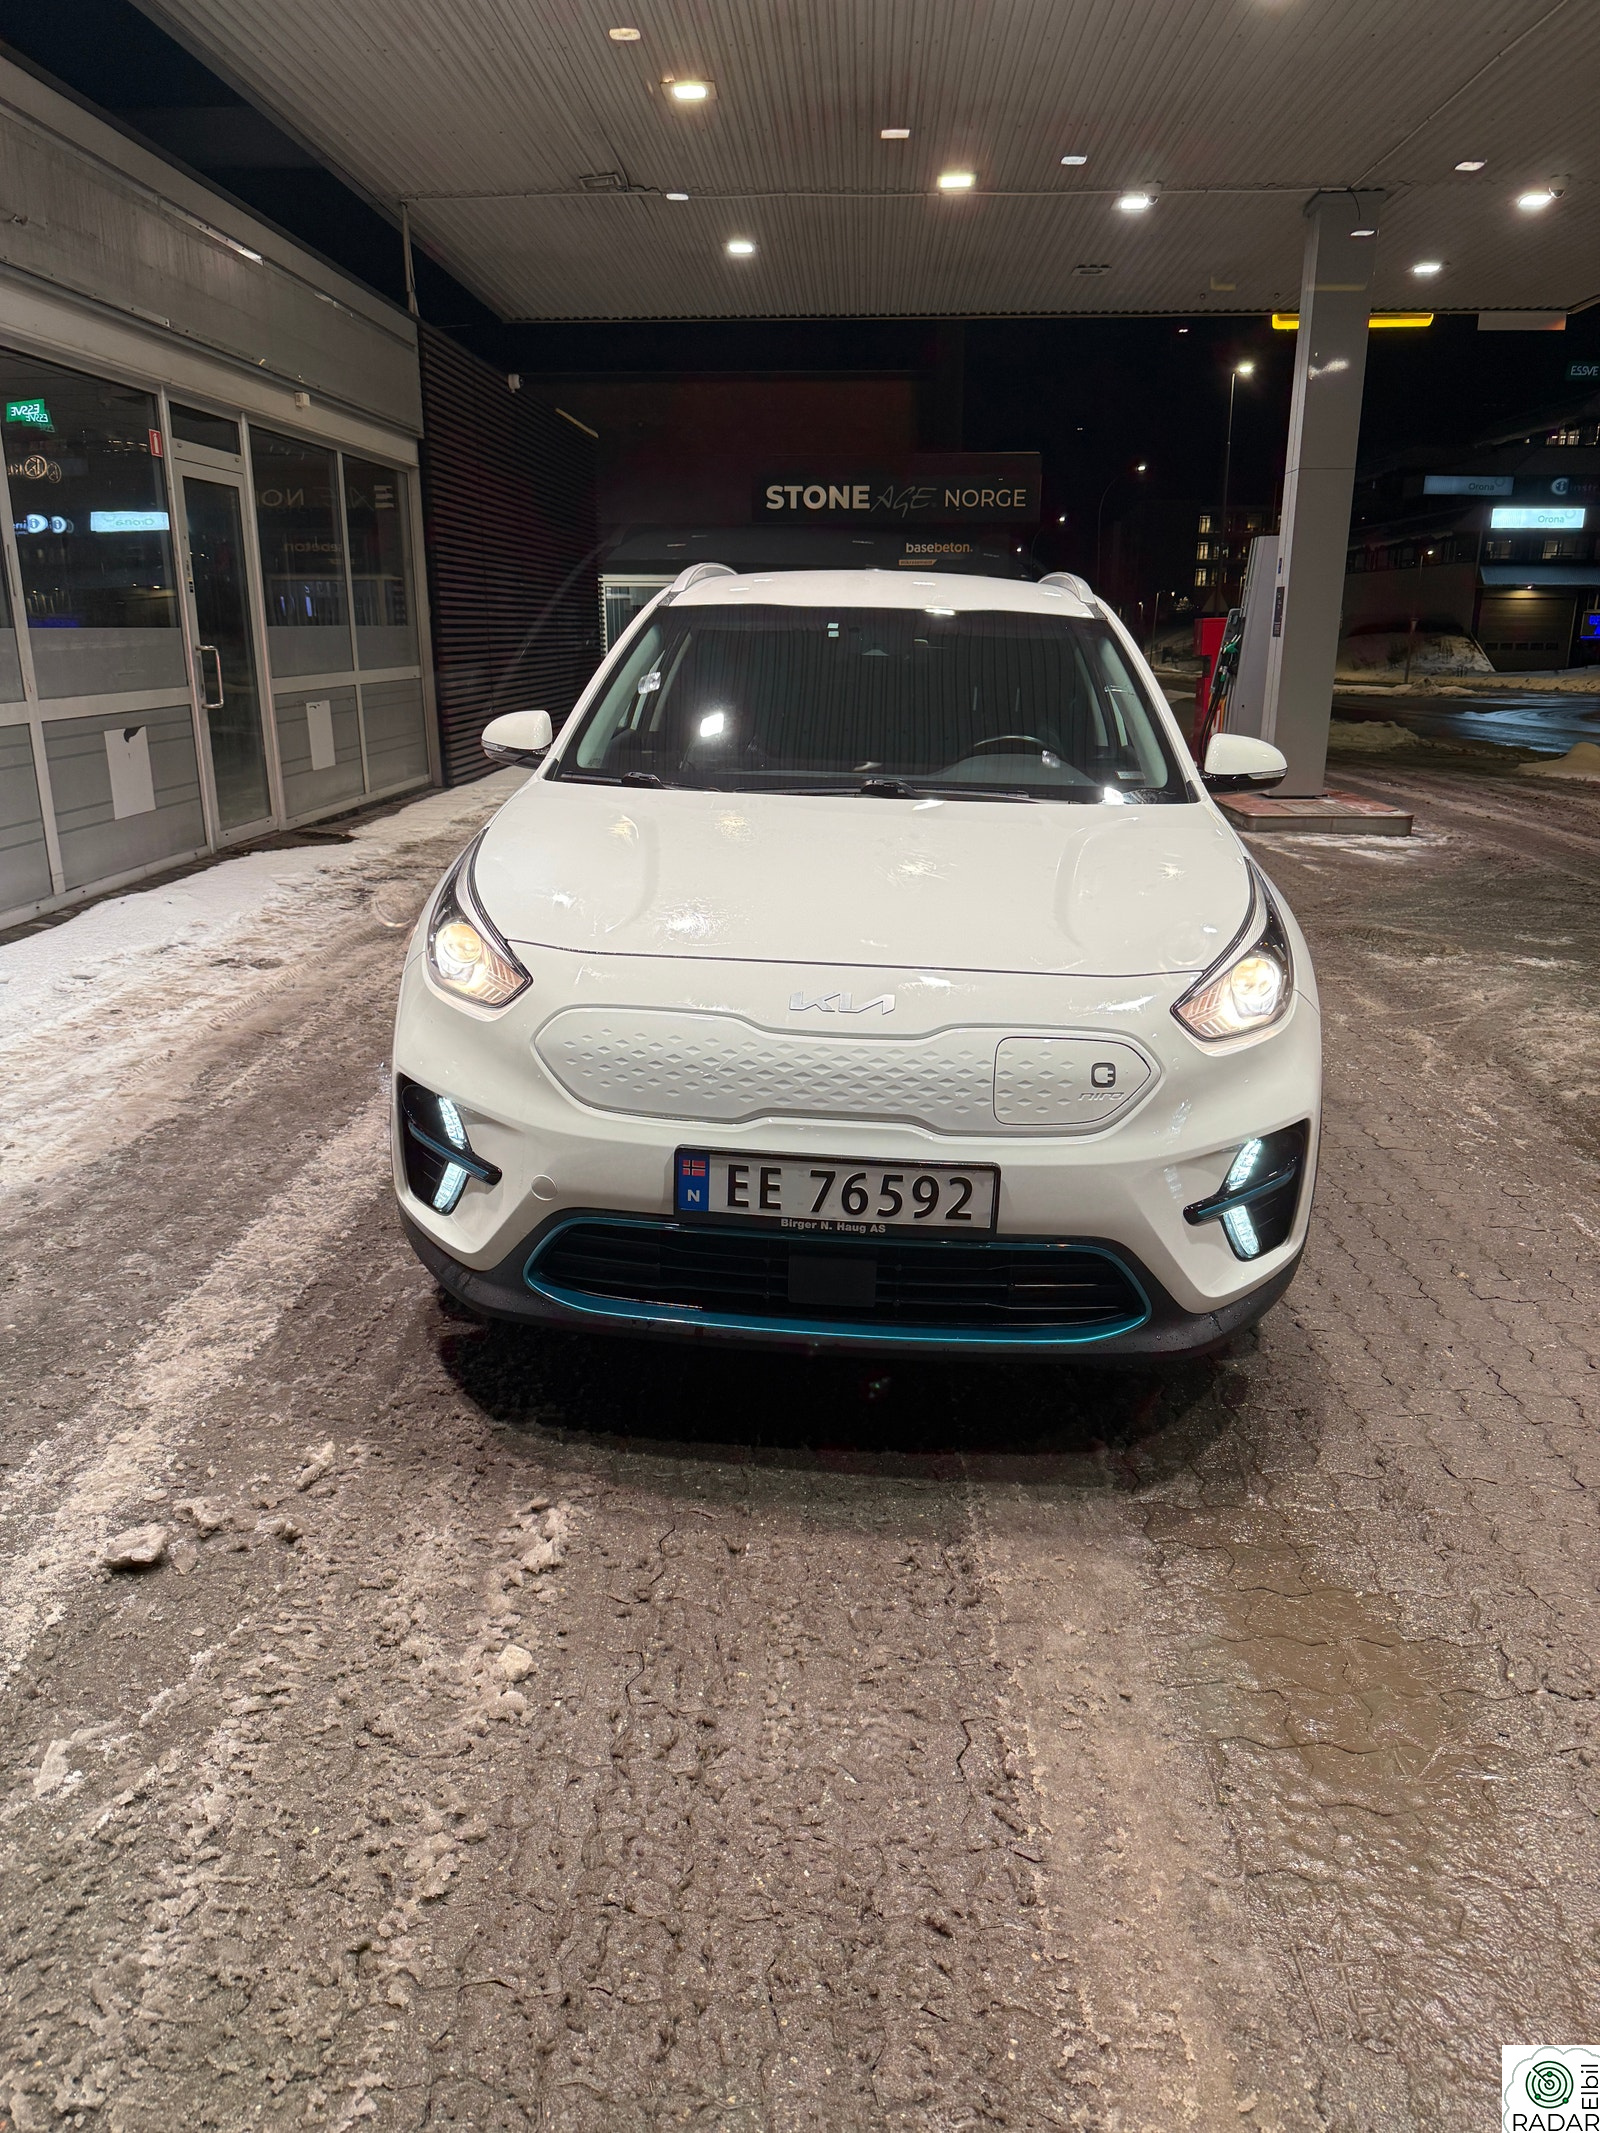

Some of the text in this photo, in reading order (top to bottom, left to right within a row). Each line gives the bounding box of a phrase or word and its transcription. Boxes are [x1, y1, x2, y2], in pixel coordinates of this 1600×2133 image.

[1570, 365, 1600, 377] ESSVE
[1468, 482, 1495, 491] Orona
[766, 485, 871, 510] STONE
[944, 489, 1027, 507] NORGE
[1537, 515, 1565, 524] Orona
[789, 991, 896, 1015] KIA
[687, 1189, 700, 1202] N
[727, 1163, 973, 1221] EE 76592
[780, 1218, 886, 1234] Birger N. Haug AS
